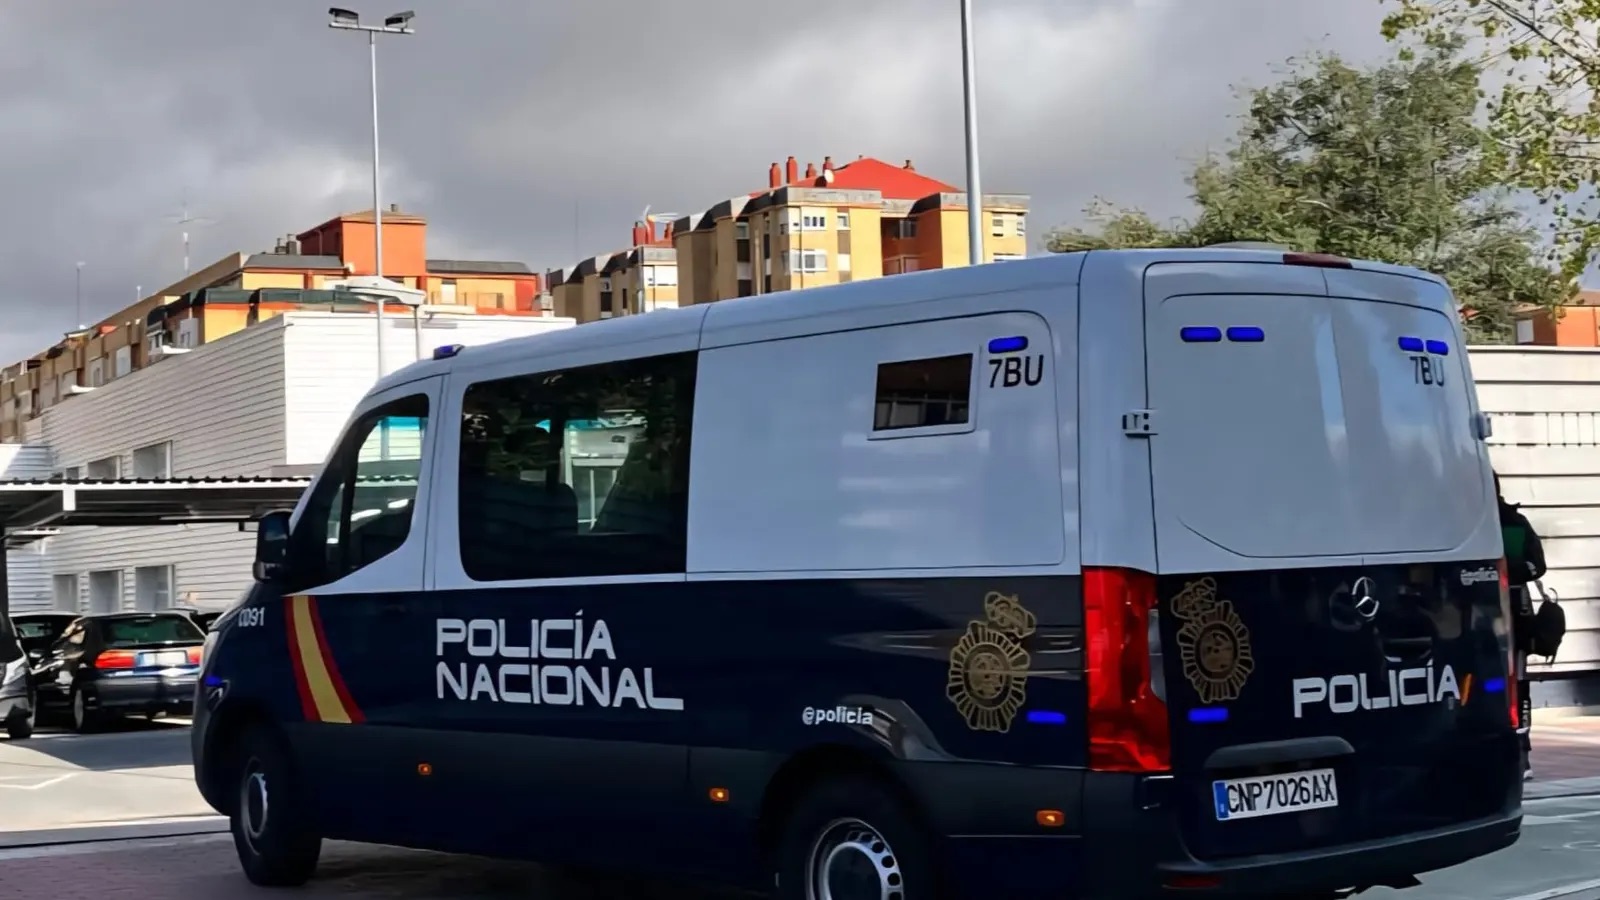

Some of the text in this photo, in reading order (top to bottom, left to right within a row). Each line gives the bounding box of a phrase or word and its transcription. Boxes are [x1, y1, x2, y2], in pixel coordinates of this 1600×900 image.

[988, 354, 1044, 388] 7BU
[1409, 356, 1444, 387] 7BU
[436, 609, 617, 660] POLICÍA
[436, 661, 684, 711] NACIONAL
[1292, 658, 1461, 718] POLICÍA
